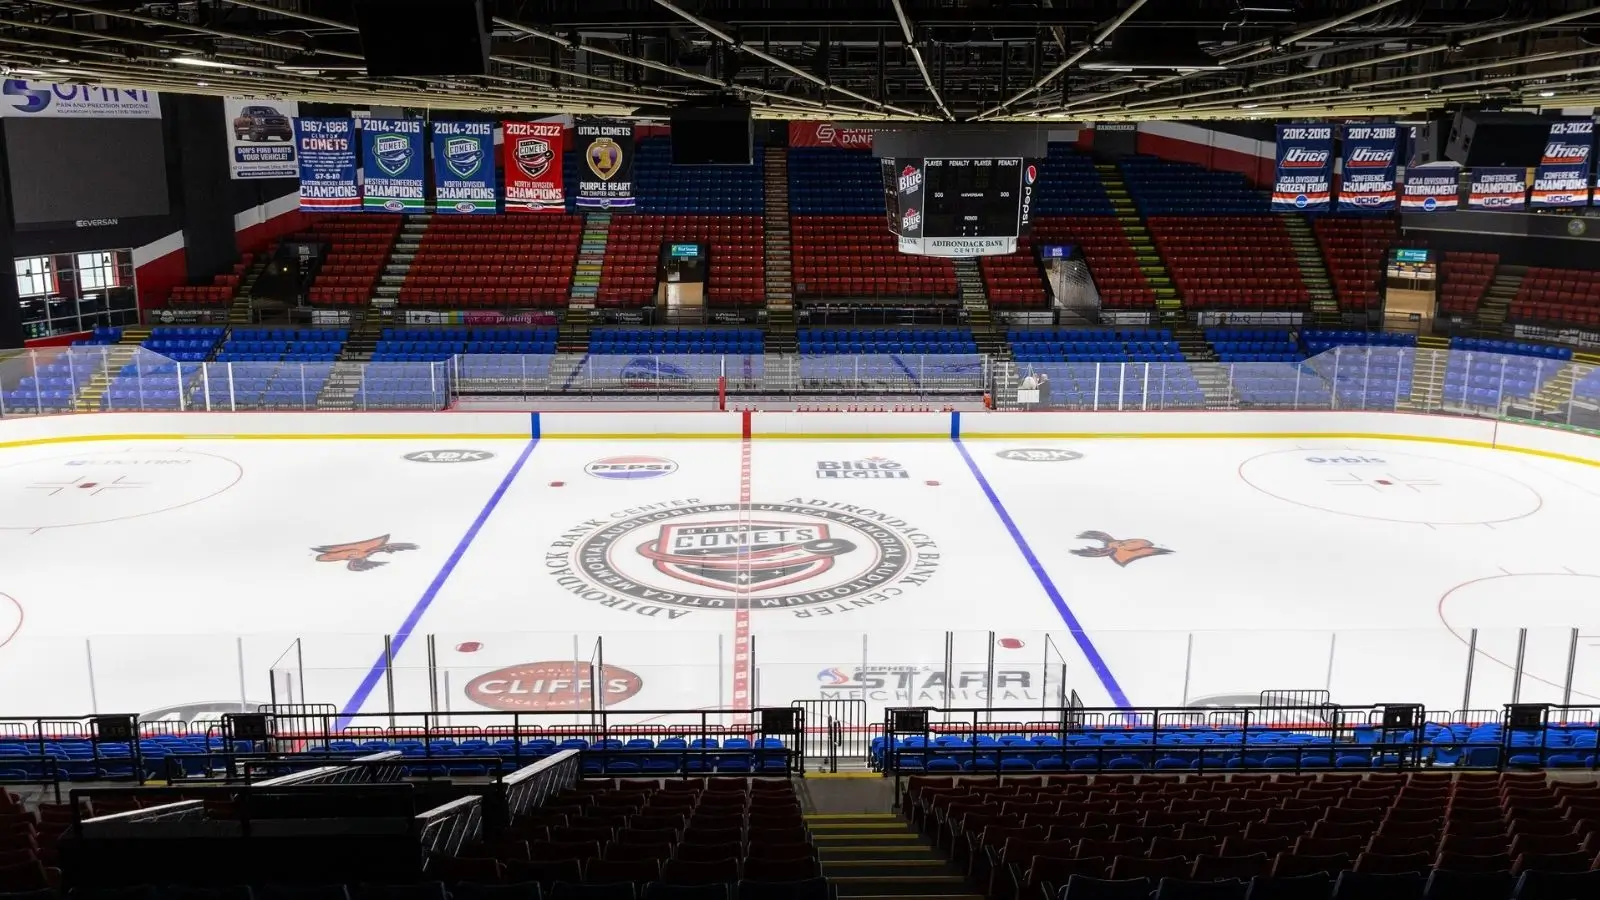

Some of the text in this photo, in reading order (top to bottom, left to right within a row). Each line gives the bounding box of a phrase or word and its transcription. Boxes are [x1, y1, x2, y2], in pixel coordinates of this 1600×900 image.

[301, 121, 348, 132] 1967-1968
[364, 120, 420, 132] 2014-2015
[435, 123, 490, 135] 2014-2015
[506, 124, 560, 136] 2021-2022
[578, 127, 631, 136] UTICA COMETS
[1283, 128, 1331, 139] 2012-2013
[1348, 128, 1396, 139] 2017-2018
[302, 139, 348, 151] COMETS
[379, 140, 406, 151] COMETS
[450, 143, 477, 153] COMETS
[520, 144, 546, 154] COMETS
[261, 153, 288, 161] VEHICLE!
[1351, 174, 1385, 182] CONFERENCE
[1481, 174, 1517, 183] CONFERENCE
[1544, 171, 1579, 179] CONFERENCE
[365, 178, 422, 187] WESTERN CONFERENCE
[580, 182, 631, 191] PURPLE HEART
[899, 172, 922, 191] Blue
[1343, 181, 1393, 192] CHAMPIONS
[1424, 177, 1449, 185] DIVISION
[1535, 179, 1587, 191] CHAMPIONS
[300, 186, 357, 197] CHAMPIONS
[365, 185, 423, 197] CHAMPIONS
[436, 187, 494, 199] CHAMPIONS
[506, 187, 562, 199] CHAMPIONS
[1276, 182, 1328, 193] FROZEN FOUR
[1404, 184, 1458, 195] TOURNAMENT
[1471, 182, 1525, 193] CHAMPIONS
[1484, 198, 1510, 206] UCHC
[903, 214, 921, 228] Blue
[412, 451, 485, 460] ADK
[1005, 450, 1072, 458] ADK
[817, 460, 902, 470] Blue
[1305, 455, 1387, 465] Orbis
[816, 470, 910, 479] LIGHT
[675, 528, 814, 549] COMETS
[545, 498, 701, 619] ADIRONDACK BANK CENTER
[586, 504, 732, 607] UTICA MEMORIAL AUDITORIUM
[760, 505, 902, 607] UTICA MEMORIAL AUDITORIUM
[786, 497, 940, 619] ADIRONDACK BANK CENTER
[853, 671, 1031, 688] STARR
[820, 690, 1038, 701] MECHANICAL
